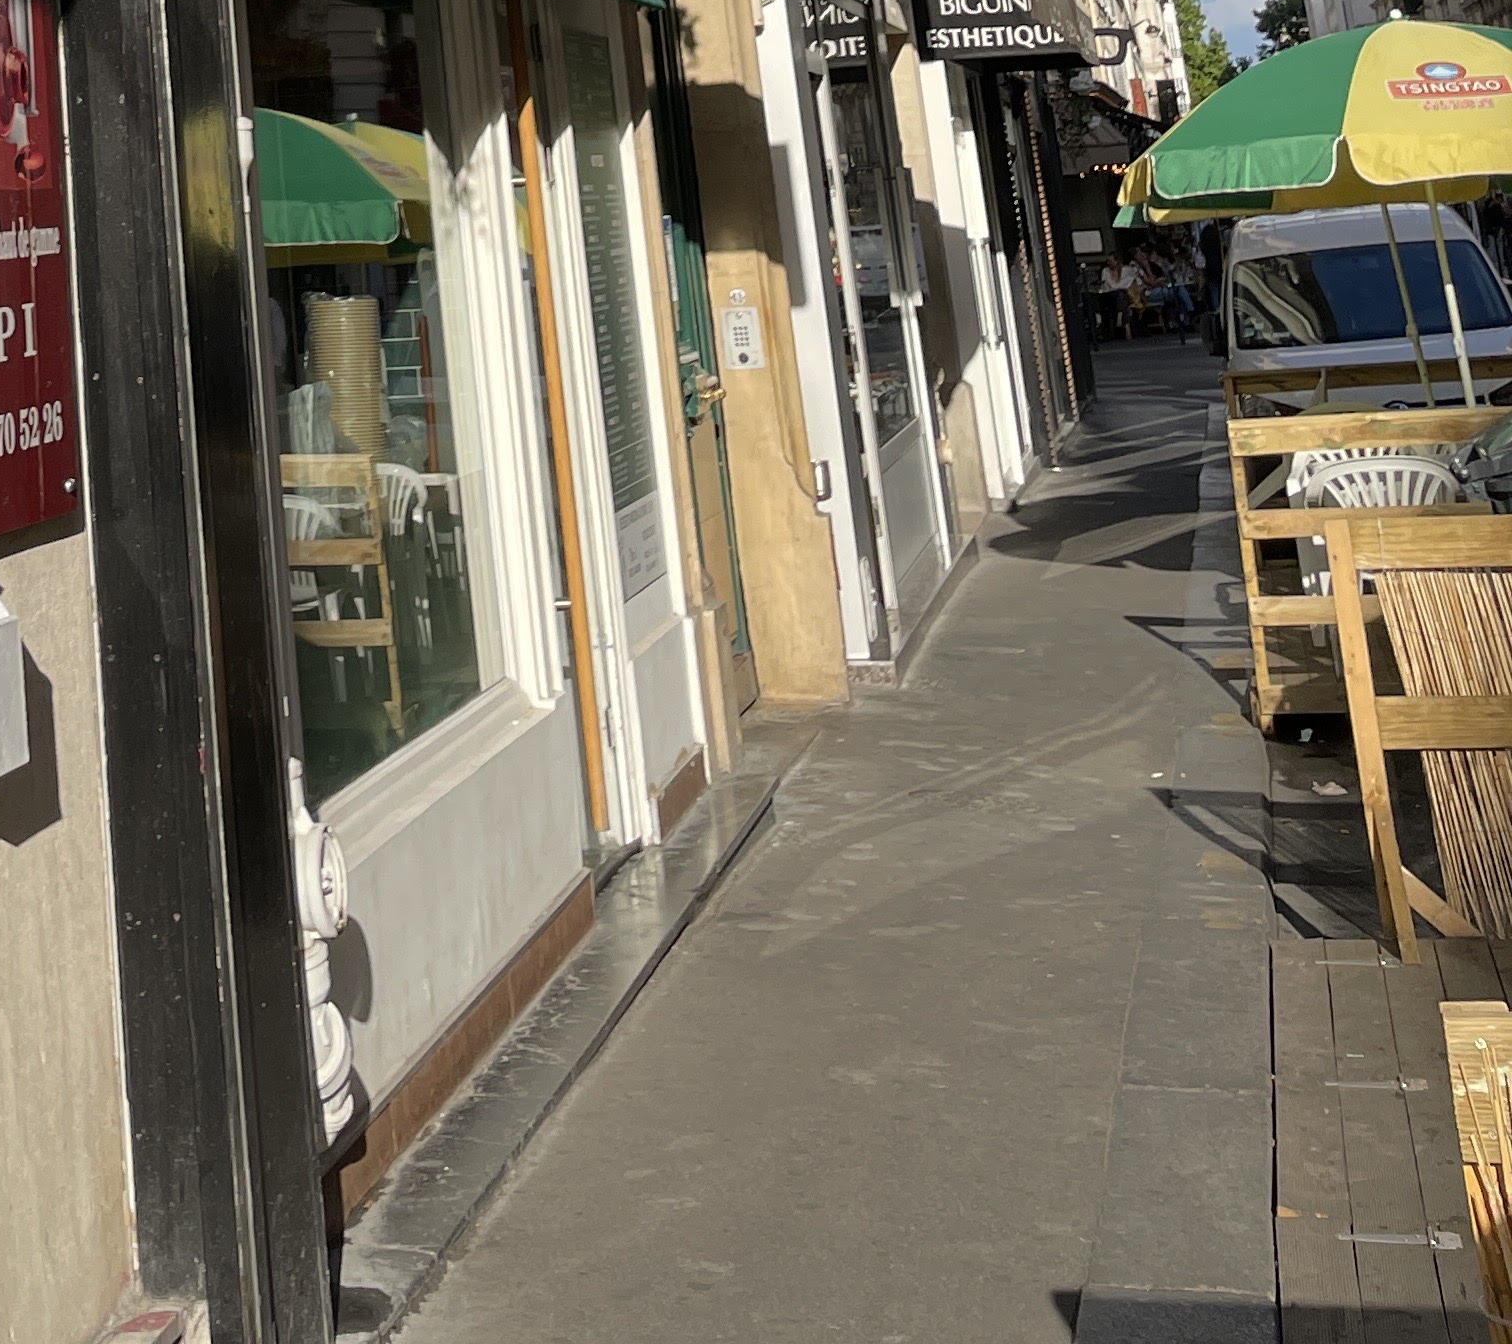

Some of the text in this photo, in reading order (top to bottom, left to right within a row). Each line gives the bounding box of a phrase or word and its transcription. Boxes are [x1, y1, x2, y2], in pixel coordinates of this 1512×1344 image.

[1396, 80, 1501, 95] TSINGTAO
[17, 216, 30, 258] de
[19, 406, 41, 451] 52
[42, 400, 64, 444] 26
